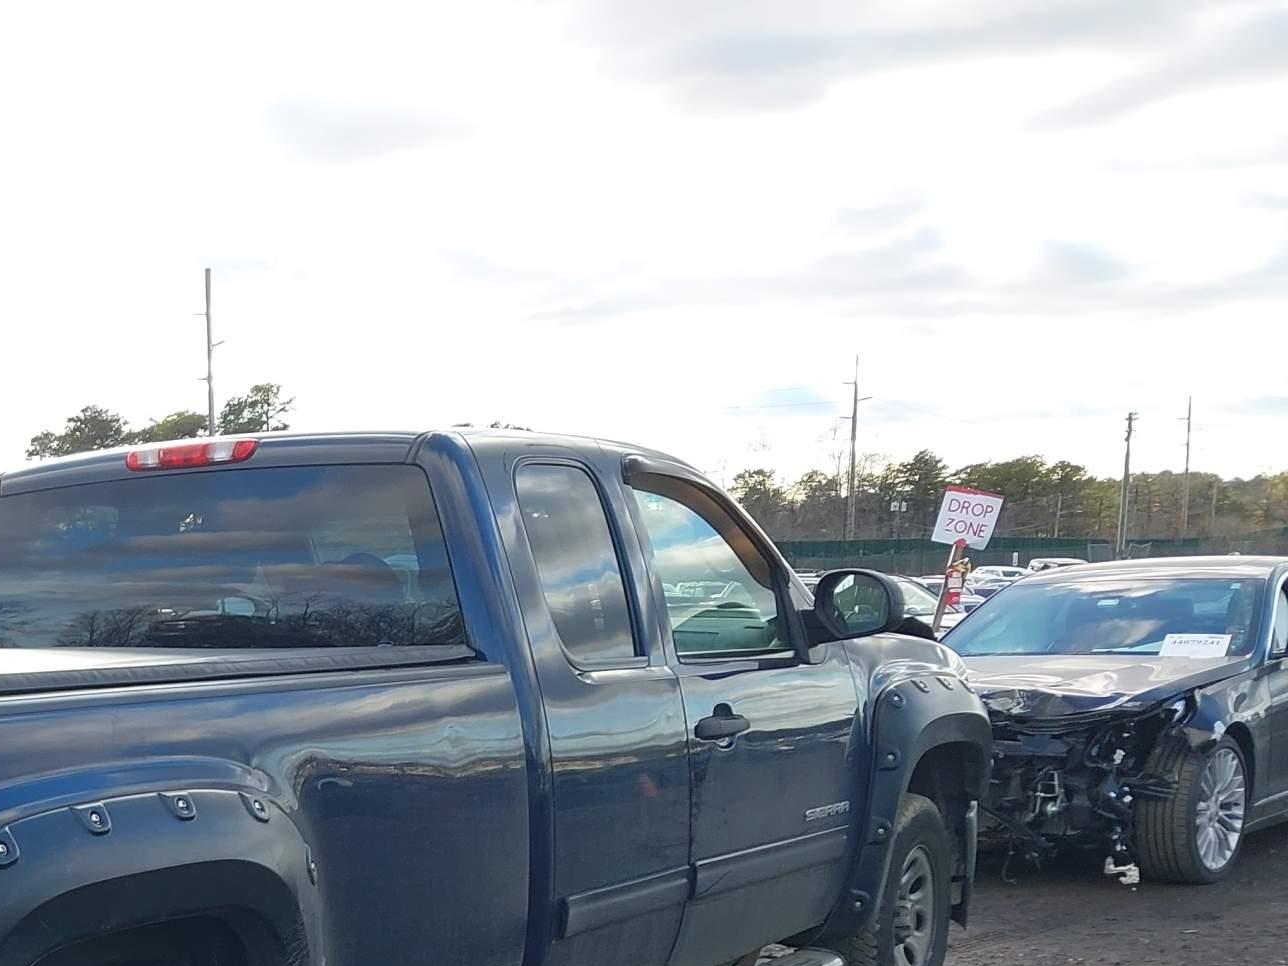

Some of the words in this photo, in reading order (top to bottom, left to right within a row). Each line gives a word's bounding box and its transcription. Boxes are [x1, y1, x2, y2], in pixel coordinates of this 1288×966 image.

[948, 498, 994, 518] DROP
[945, 518, 988, 538] ZONE
[805, 800, 850, 822] SIERRA
